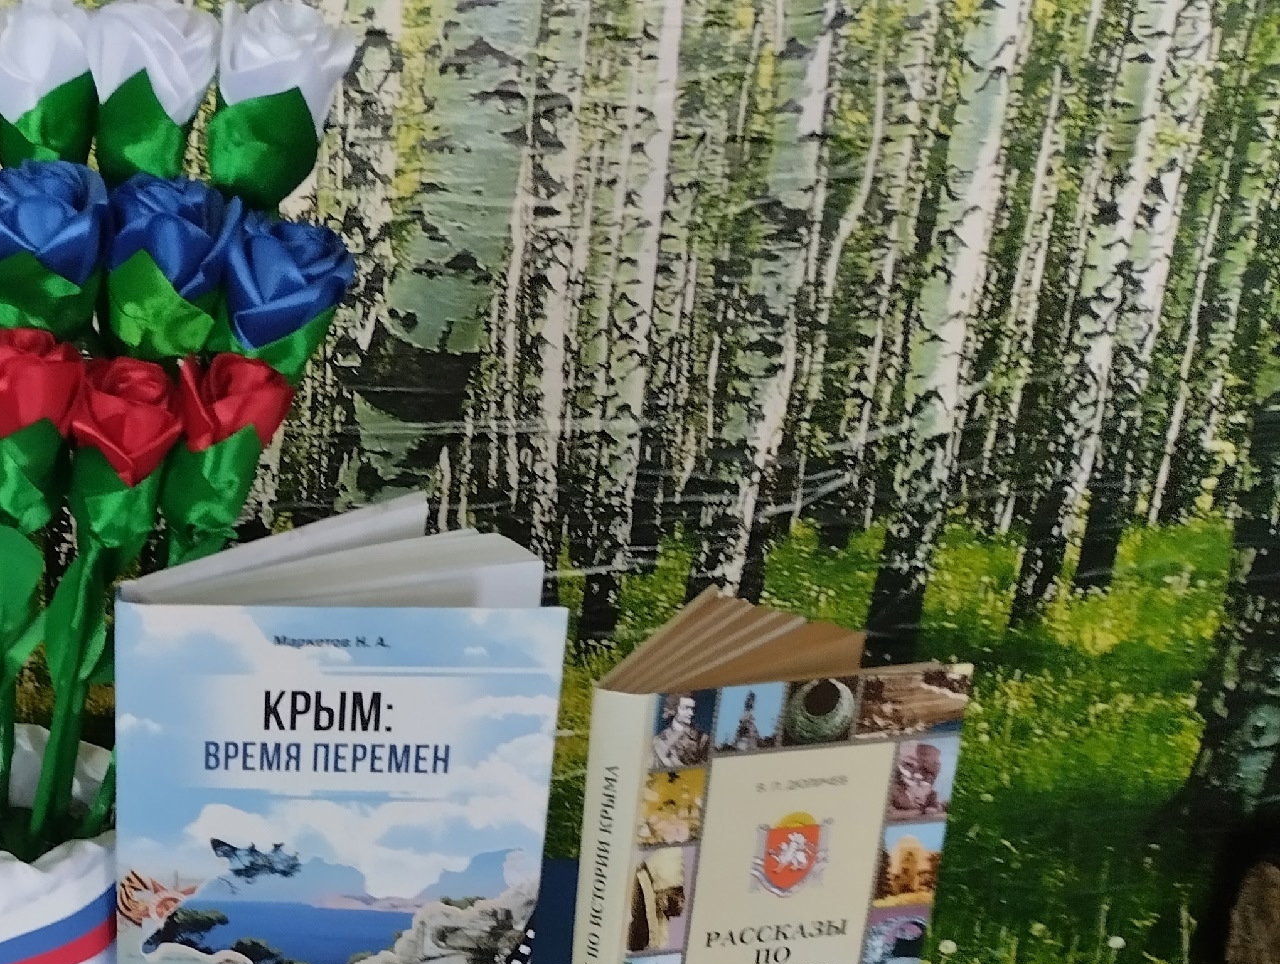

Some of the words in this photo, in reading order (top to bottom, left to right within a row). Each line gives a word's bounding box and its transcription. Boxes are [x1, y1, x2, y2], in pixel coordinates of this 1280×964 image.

[263, 689, 394, 733] КРЫМ:
[203, 740, 302, 773] ВРЕМЯ
[312, 742, 451, 774] ПЕРЕМЕН
[599, 765, 620, 834] КРЫМА
[589, 840, 611, 928] ИСТОРИИ
[586, 932, 600, 959] ПО
[704, 919, 849, 949] РАССКАЗЫ
[754, 947, 792, 964] ПО
